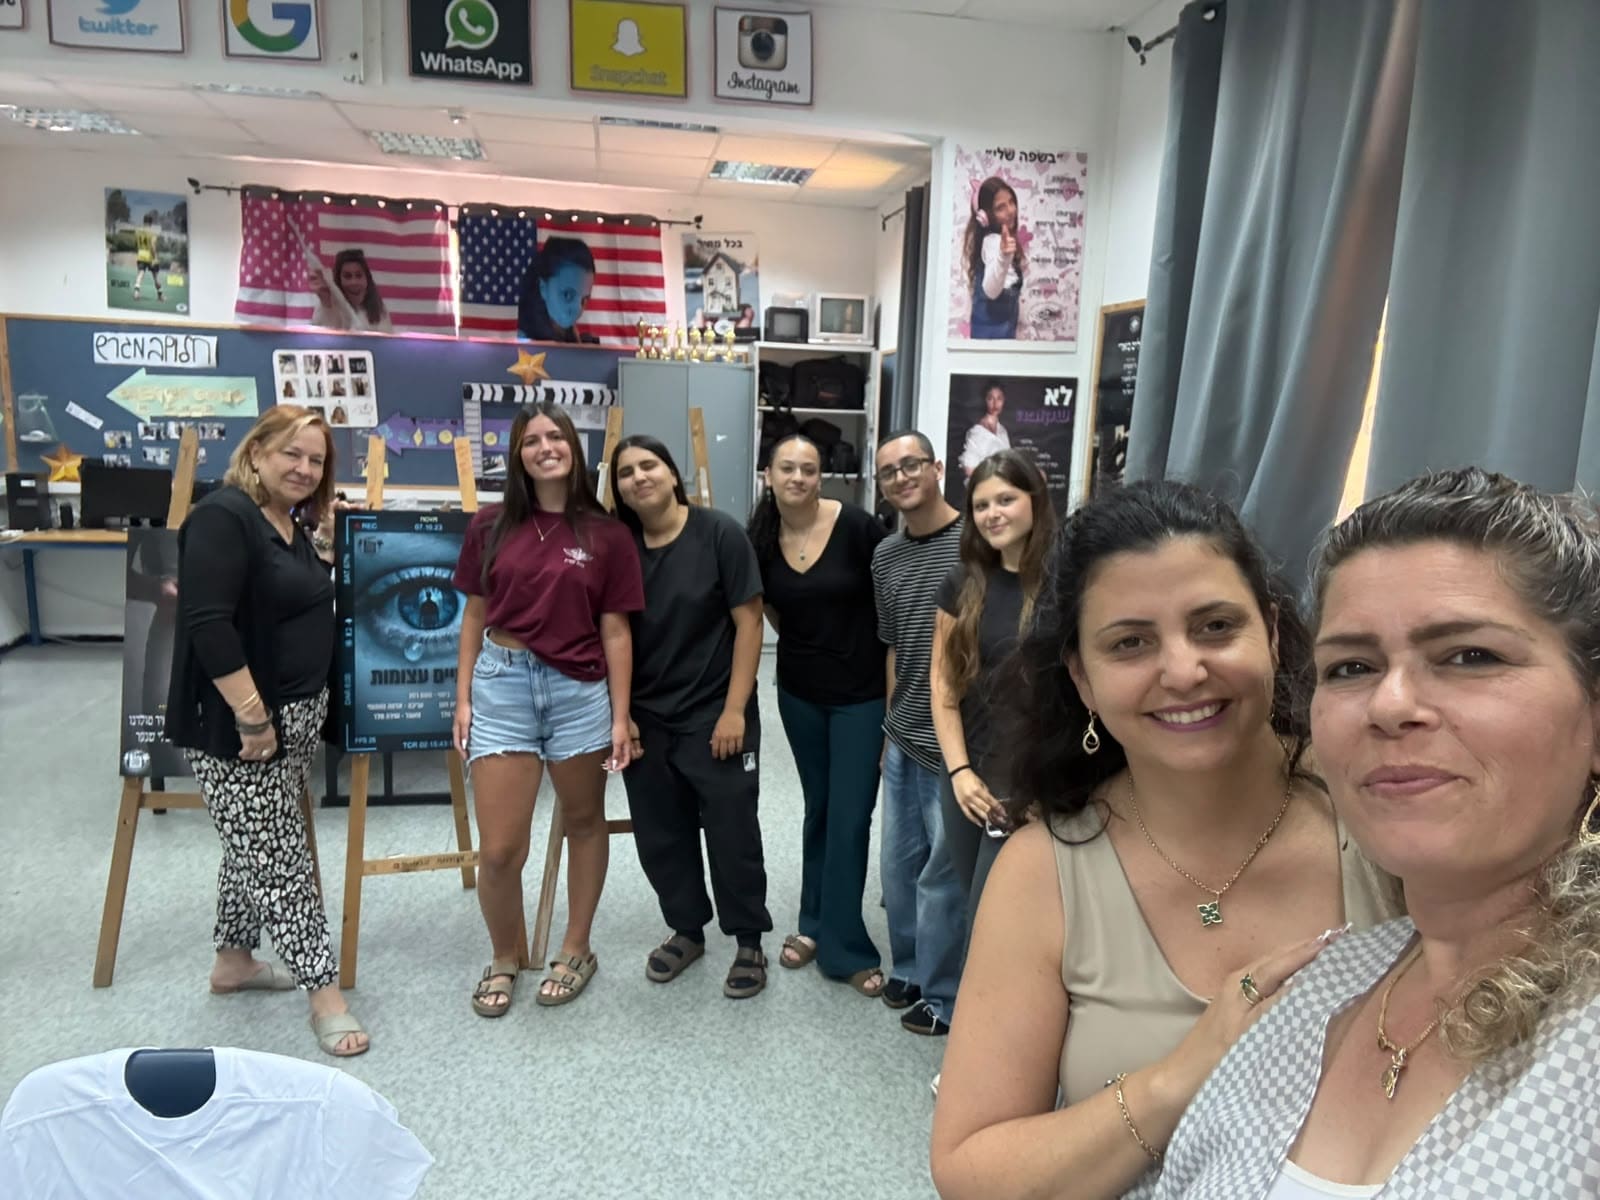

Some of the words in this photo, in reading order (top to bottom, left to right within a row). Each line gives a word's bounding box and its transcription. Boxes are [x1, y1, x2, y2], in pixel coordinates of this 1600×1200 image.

[78, 15, 158, 37] twitter
[420, 51, 524, 80] WhatsApp
[589, 64, 668, 87] Snapchat
[727, 71, 801, 100] Instagram
[723, 237, 743, 248] בכל
[1043, 385, 1073, 406] לא
[370, 668, 429, 685] עצומות
